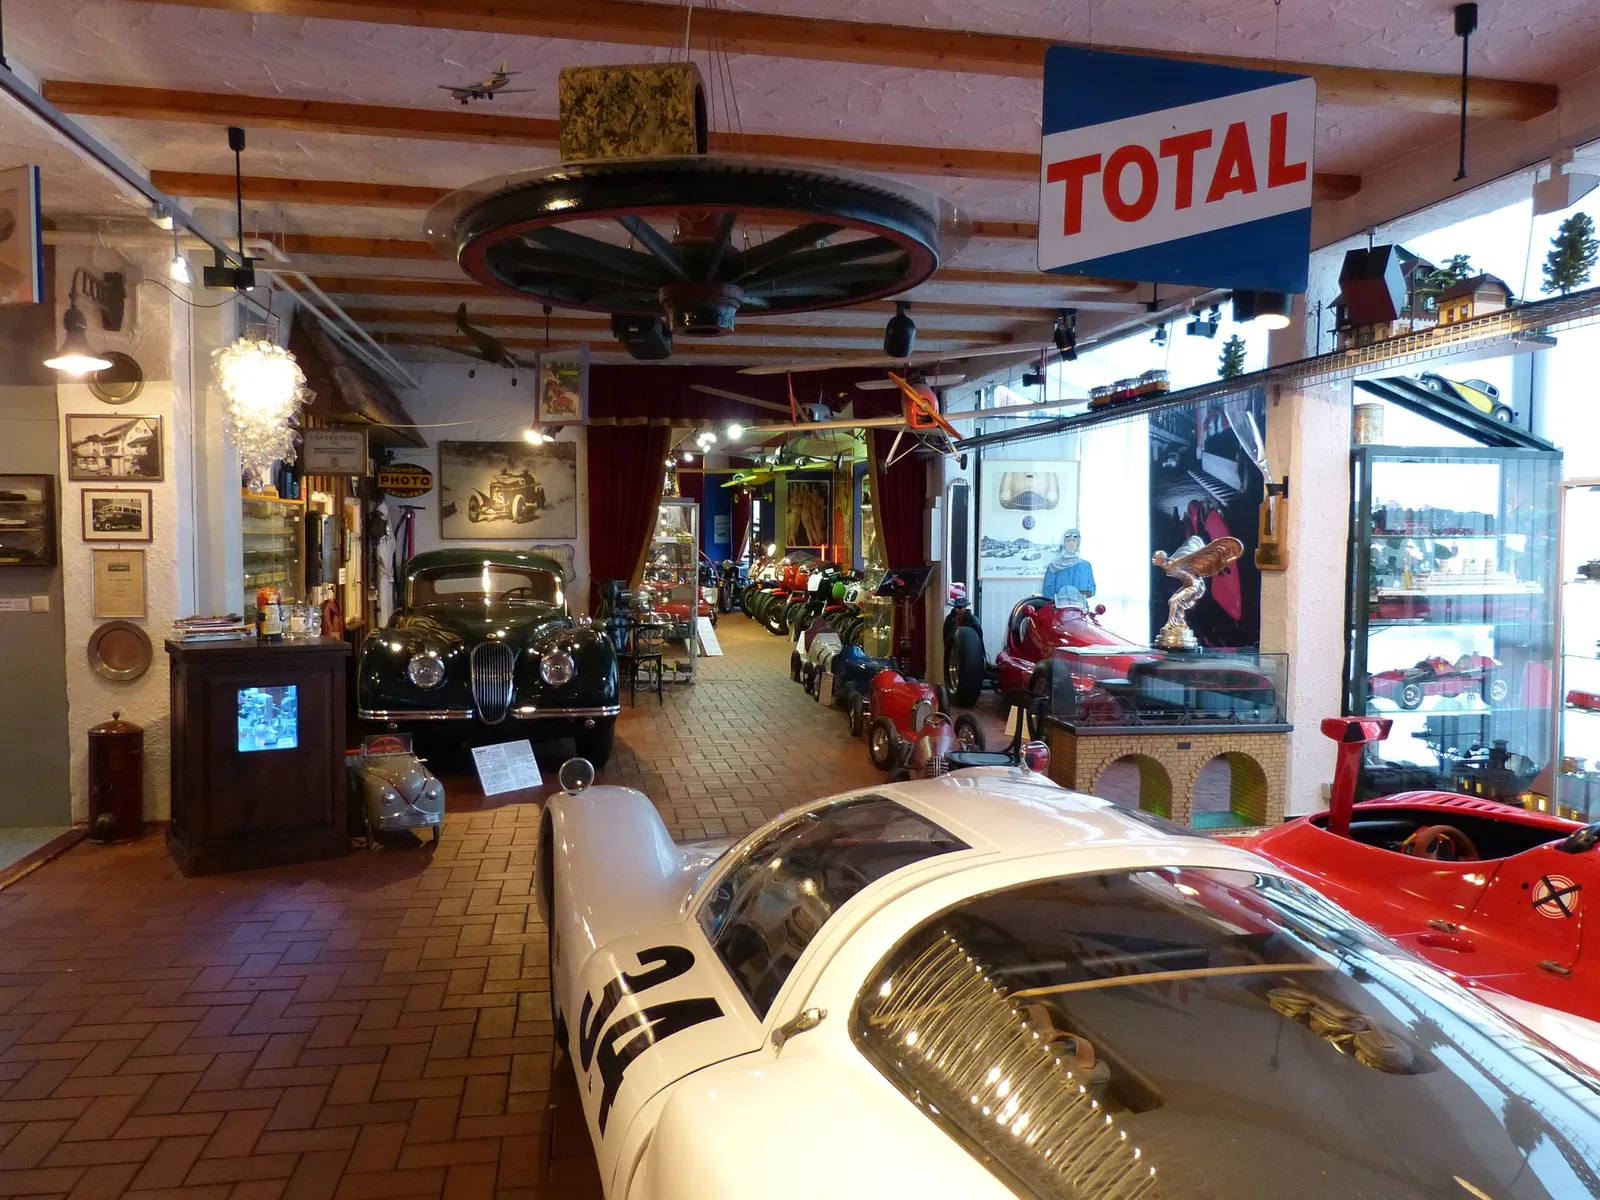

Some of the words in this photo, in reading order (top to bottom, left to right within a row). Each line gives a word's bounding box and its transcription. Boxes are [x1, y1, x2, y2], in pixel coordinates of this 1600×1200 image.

[1047, 111, 1307, 236] TOTAL
[380, 475, 430, 486] PHOTO
[492, 492, 505, 504] 45
